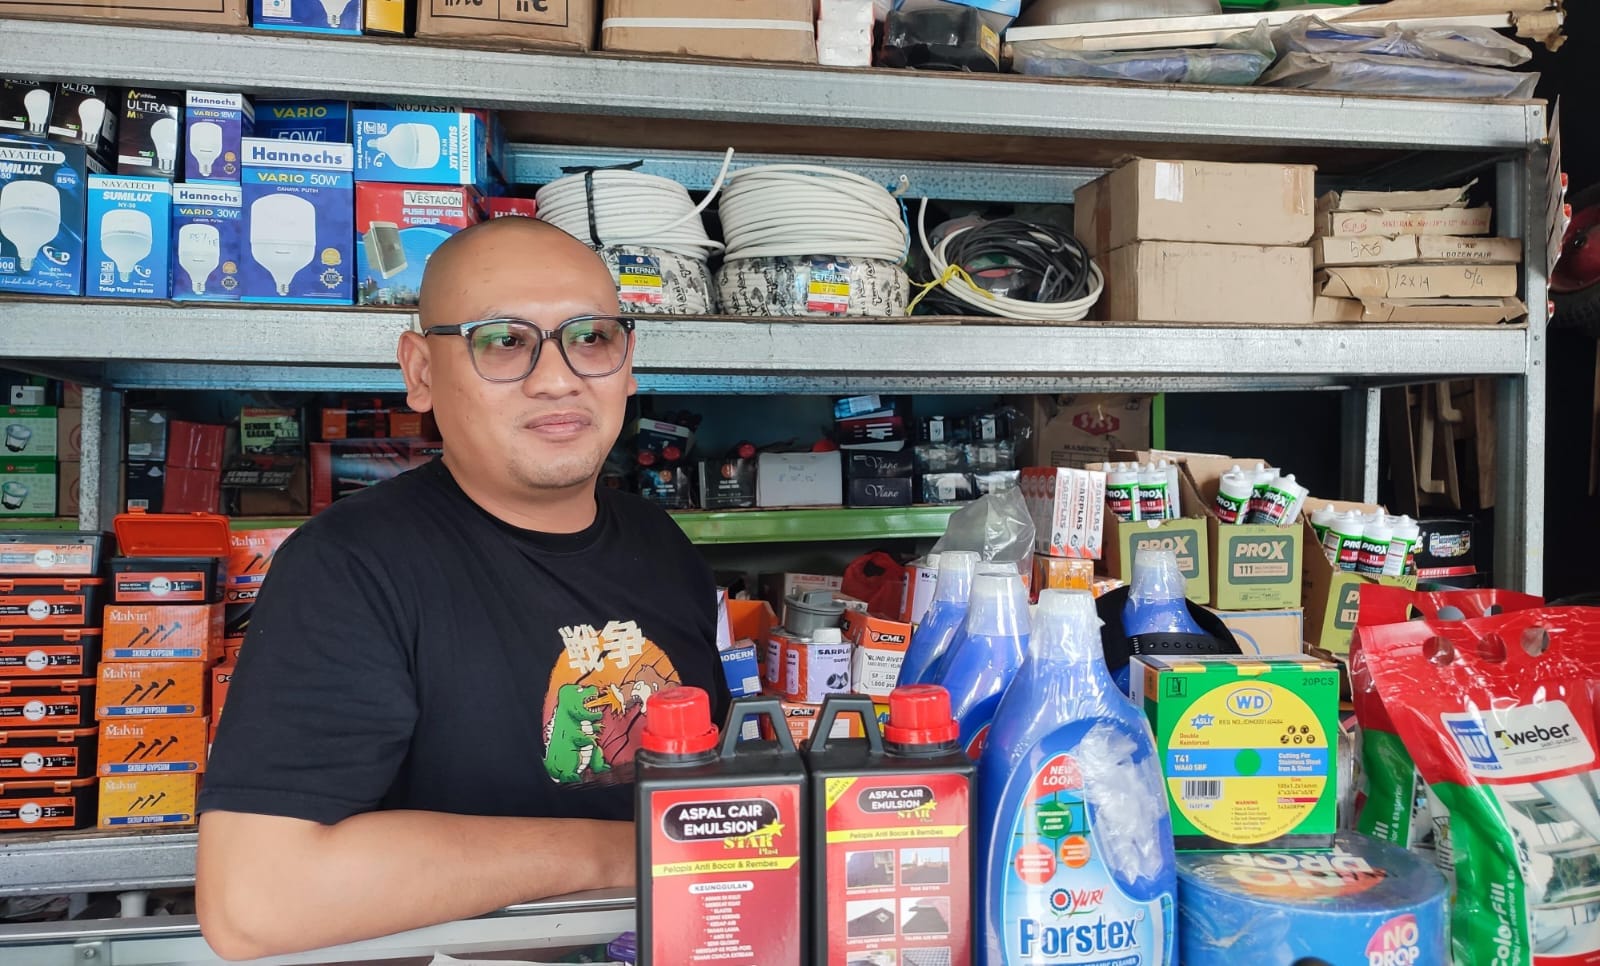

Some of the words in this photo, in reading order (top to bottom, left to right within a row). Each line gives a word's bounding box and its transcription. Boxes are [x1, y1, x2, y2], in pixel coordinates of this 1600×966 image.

[127, 100, 168, 113] ULTRA
[191, 96, 236, 106] Hannochs
[272, 107, 327, 118] VARIO
[448, 126, 459, 170] SUMILUX
[0, 150, 55, 161] AYATECH
[253, 147, 342, 164] Hannochs
[0, 163, 42, 175] MILUX
[258, 173, 304, 183] VARIO
[102, 181, 155, 190] NAYATECH
[103, 191, 152, 202] SUMILUX
[180, 191, 238, 202] Hannochs
[410, 193, 462, 205] VESTACON
[180, 208, 213, 216] VARIO
[427, 208, 444, 216] BOX
[624, 266, 656, 275] ETERNA
[1216, 496, 1239, 511] PROX
[232, 536, 265, 547] Malvin
[1138, 535, 1191, 554] PROX
[1343, 539, 1361, 549] PRO
[1236, 541, 1287, 559] PROX
[1362, 542, 1388, 555] PROX
[1240, 565, 1254, 574] 111
[238, 591, 257, 600] CM
[110, 609, 148, 621] Malvin
[880, 634, 904, 643] CML
[132, 649, 150, 657] SKRUP
[151, 649, 174, 657] GYPSUM
[103, 667, 141, 679] Malvin
[1302, 677, 1334, 686] 20PCS
[1236, 695, 1265, 710] WD
[125, 706, 144, 714] SKRUP
[145, 706, 168, 714] GYPSUM
[1194, 717, 1211, 726] ASLI
[105, 724, 144, 736] Malvin
[1508, 723, 1570, 746] weber
[1174, 755, 1189, 763] T41
[127, 764, 146, 772] SKRUP
[147, 763, 170, 771] GYPSUM
[105, 781, 137, 791] Malvin
[868, 791, 899, 800] ASPAL
[900, 789, 924, 798] CAIR
[871, 800, 920, 810] EMULSION
[678, 806, 726, 820] ASPAL
[728, 804, 763, 818] CAIR
[897, 809, 930, 819] STAR
[144, 815, 164, 823] GYPSUM
[684, 820, 758, 836] EMULSION
[1372, 820, 1389, 840] ill
[723, 834, 774, 849] STAR
[850, 832, 874, 840] Pelapis
[663, 864, 692, 873] Pelapis
[694, 862, 711, 871] Anti
[713, 861, 736, 869] Bocor
[746, 860, 778, 868] Rembes
[694, 882, 748, 892] KEUNGGULAN
[1019, 915, 1137, 956] Porstex
[1384, 922, 1418, 949] NO
[1369, 946, 1420, 966] DROP
